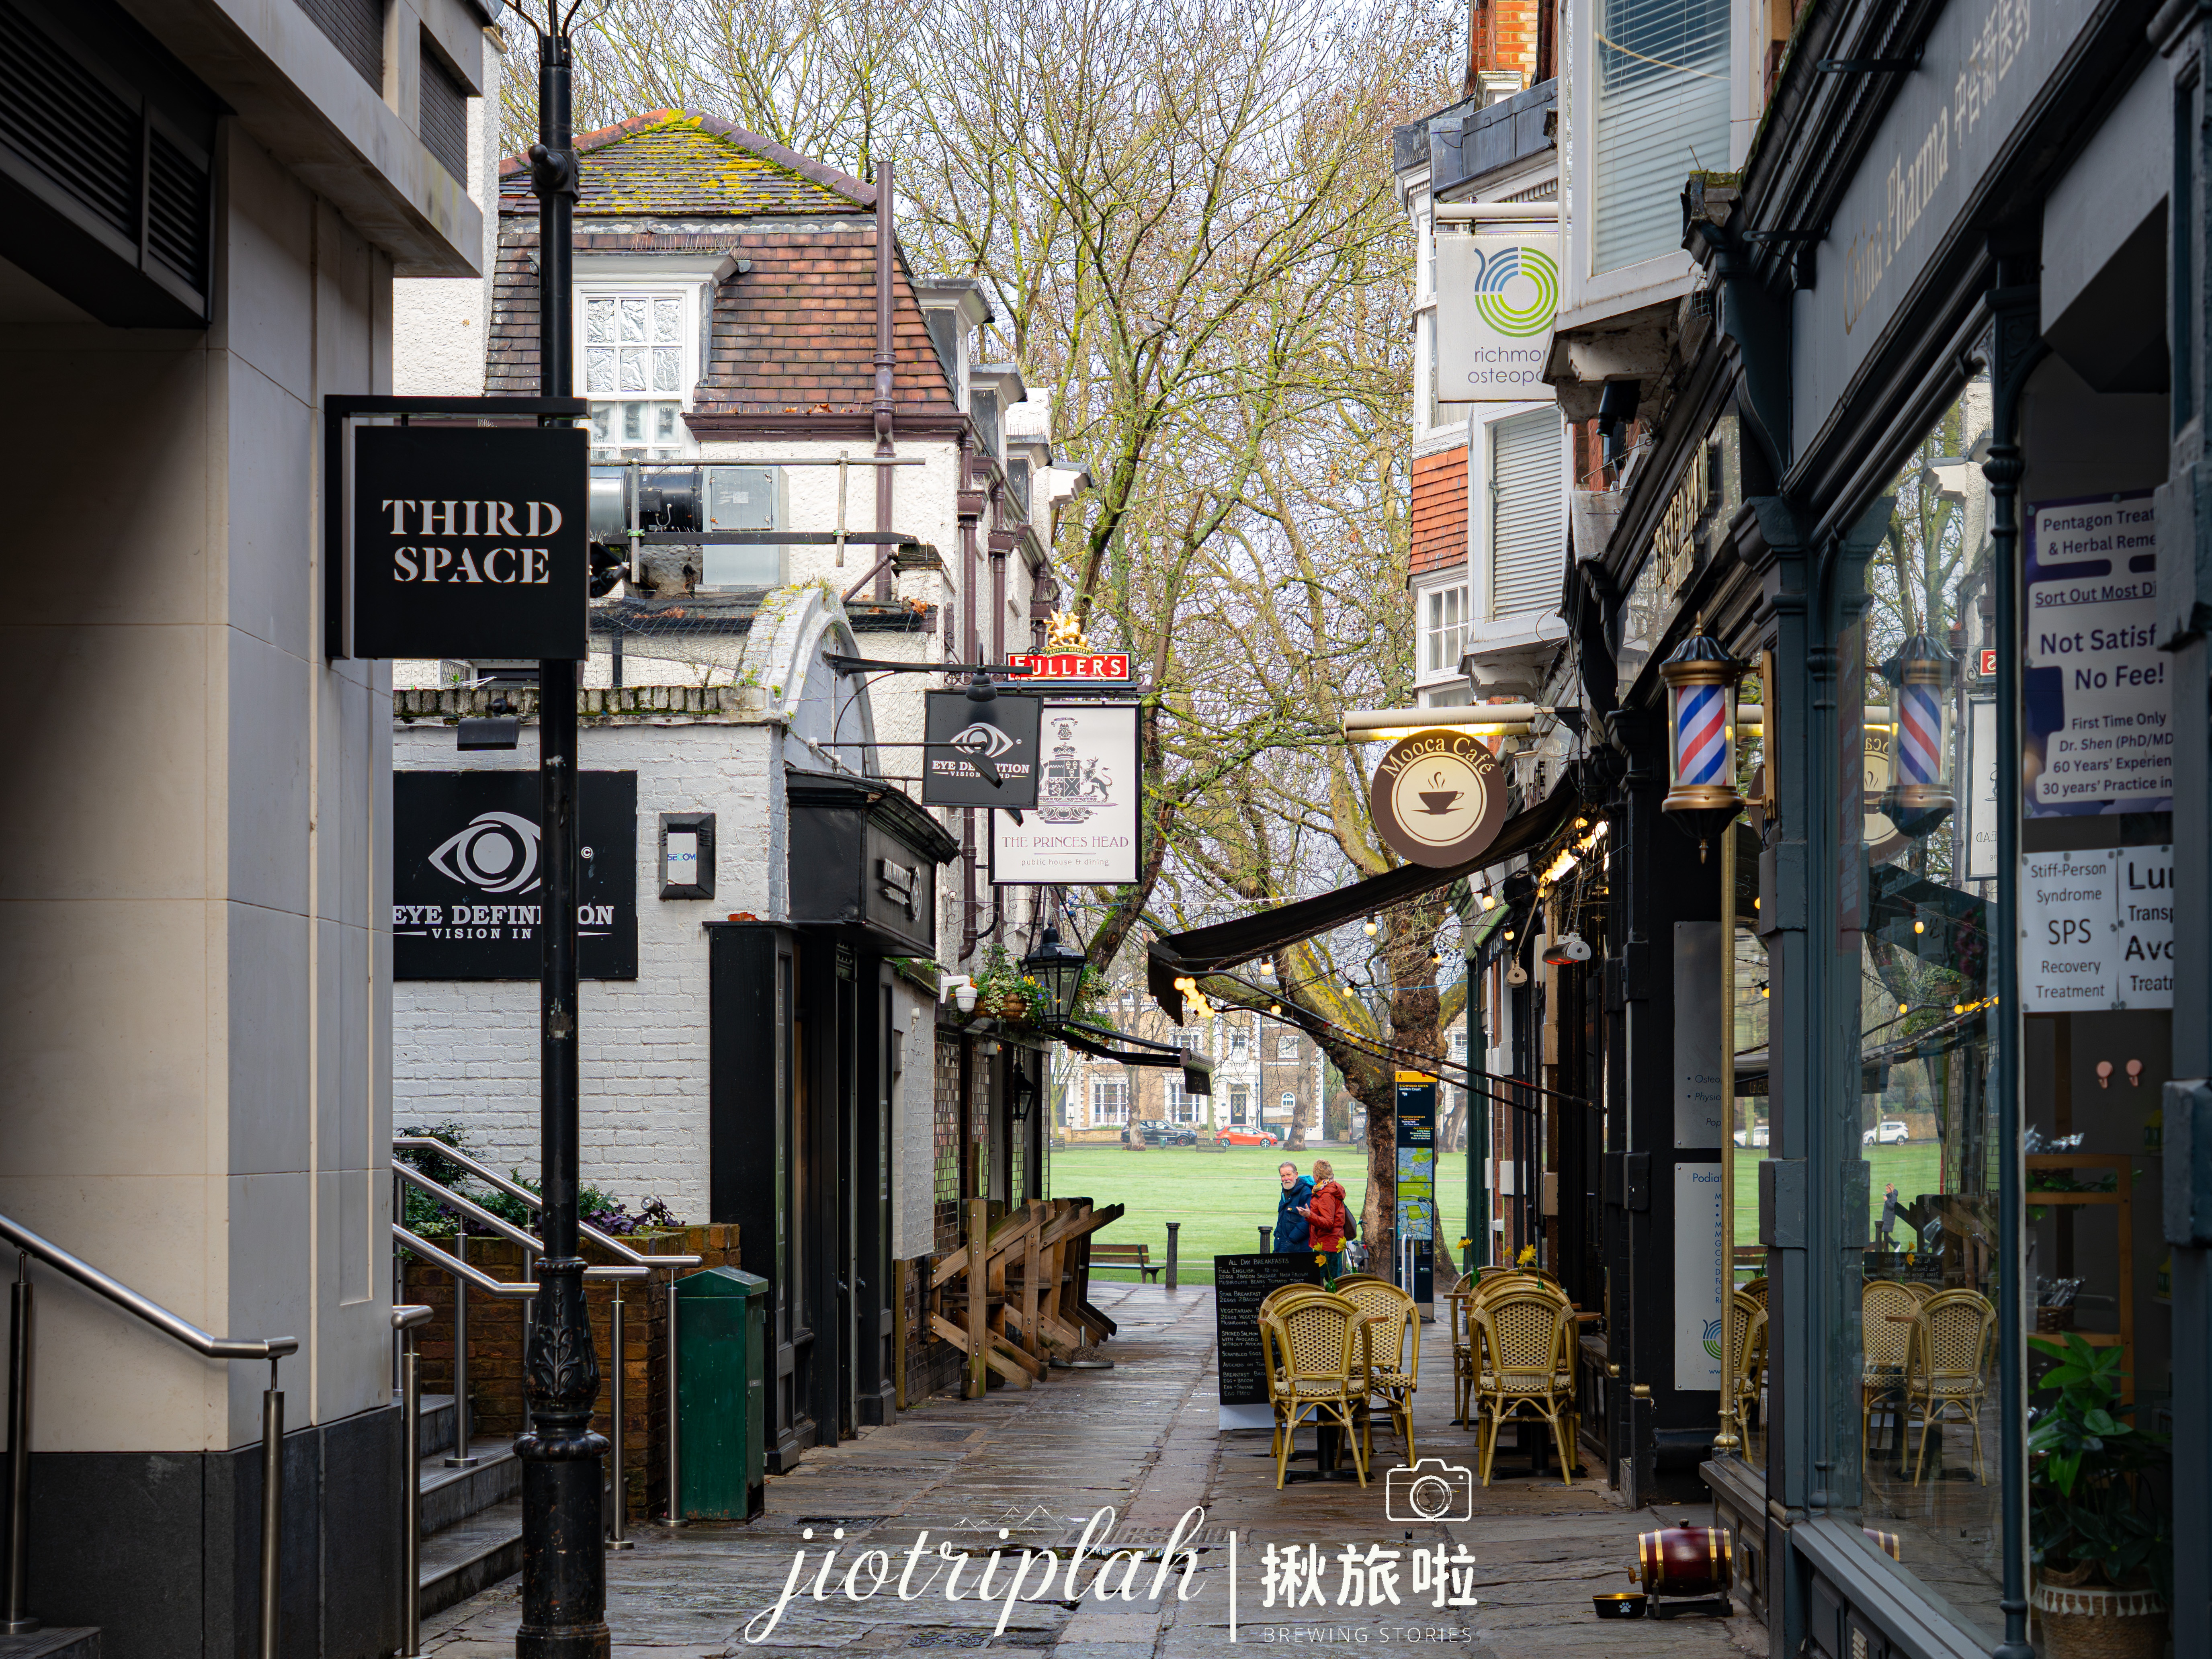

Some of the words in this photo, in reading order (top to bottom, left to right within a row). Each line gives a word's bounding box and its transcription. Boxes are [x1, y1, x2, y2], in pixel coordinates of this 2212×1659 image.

[1843, 218, 1882, 336] China
[1886, 106, 1949, 267] Pharma
[382, 500, 562, 536] THIRD
[2044, 512, 2112, 532] Pentagon
[2048, 542, 2058, 555] &
[2063, 536, 2112, 554] Herbal
[2117, 534, 2156, 549] Reme
[394, 547, 549, 583] SPACE
[2035, 591, 2066, 606] Sort
[2070, 587, 2097, 602] Out
[2102, 583, 2138, 599] Most
[2041, 631, 2084, 655] Not
[1014, 655, 1121, 677] FULLER'S
[2075, 668, 2107, 690] No
[2116, 662, 2164, 688] Fee!
[2072, 717, 2099, 730] First
[2103, 715, 2134, 728] Time
[2137, 711, 2167, 727] Only
[2059, 741, 2077, 752] Dr.
[2081, 737, 2112, 750] Shen
[2116, 732, 2174, 750] (PhD/MD
[932, 760, 956, 770] EYE
[1380, 738, 1446, 778] Mooca
[1453, 737, 1495, 775] Café
[2054, 761, 2070, 773] 60
[2116, 754, 2172, 772] Experien
[2043, 783, 2059, 795] 30
[2104, 776, 2157, 791] Practice
[2160, 776, 2173, 789] in
[1002, 836, 1028, 848] THE
[1033, 836, 1088, 848] PRINCES
[1092, 836, 1129, 848] HEAD
[668, 853, 696, 861] SECOM
[1021, 858, 1046, 866] public
[1084, 858, 1110, 866] dining
[2031, 863, 2107, 878] Stiff-Person
[2036, 887, 2102, 905] Syndrome
[392, 905, 443, 924] EYE
[432, 928, 501, 938] VISION
[512, 928, 532, 938] IN
[2048, 918, 2091, 945] SPS
[2041, 960, 2101, 975] Recovery
[2036, 985, 2105, 998] Treatment
[1695, 1075, 1721, 1084] Osteo
